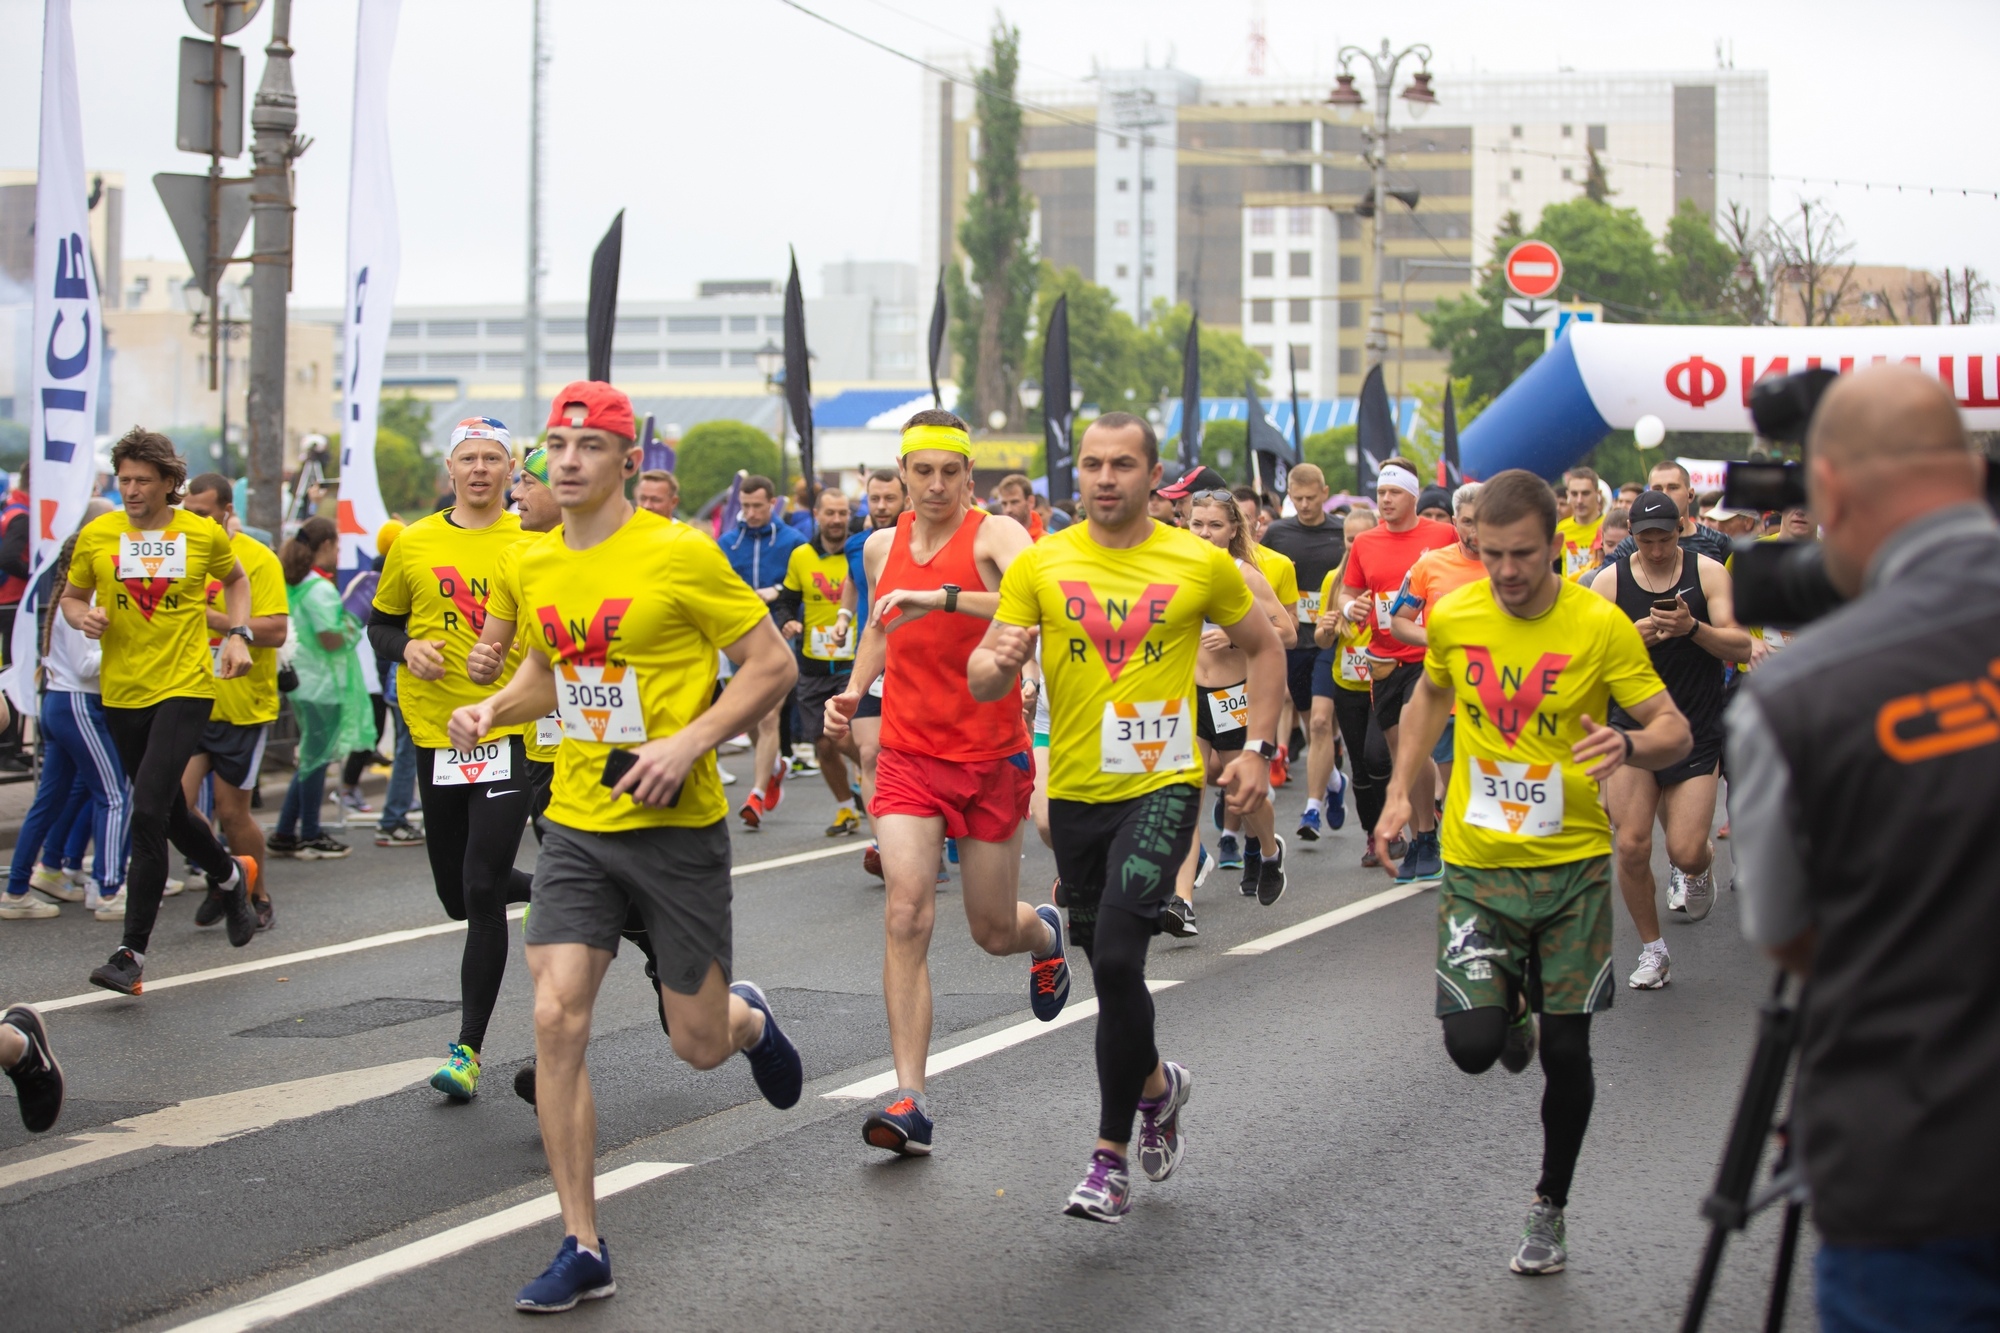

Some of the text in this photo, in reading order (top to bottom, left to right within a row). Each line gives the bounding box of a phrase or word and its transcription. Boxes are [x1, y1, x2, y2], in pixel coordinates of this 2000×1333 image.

[42, 232, 89, 464] ПСБ
[130, 542, 175, 556] 3036
[439, 577, 488, 598] ON
[812, 577, 840, 588] ON
[116, 594, 179, 611] RUN
[1065, 596, 1167, 624] ONE
[443, 610, 488, 631] RU
[543, 616, 622, 649] ONE
[1069, 638, 1163, 665] RUN
[1465, 661, 1561, 695] ONE
[566, 684, 624, 708] 3058
[1218, 694, 1247, 713] 304
[1117, 717, 1179, 741] 3117
[1466, 703, 1557, 736] RUN
[447, 744, 499, 764] 2000
[466, 767, 479, 776] 10
[1483, 776, 1546, 804] 3106
